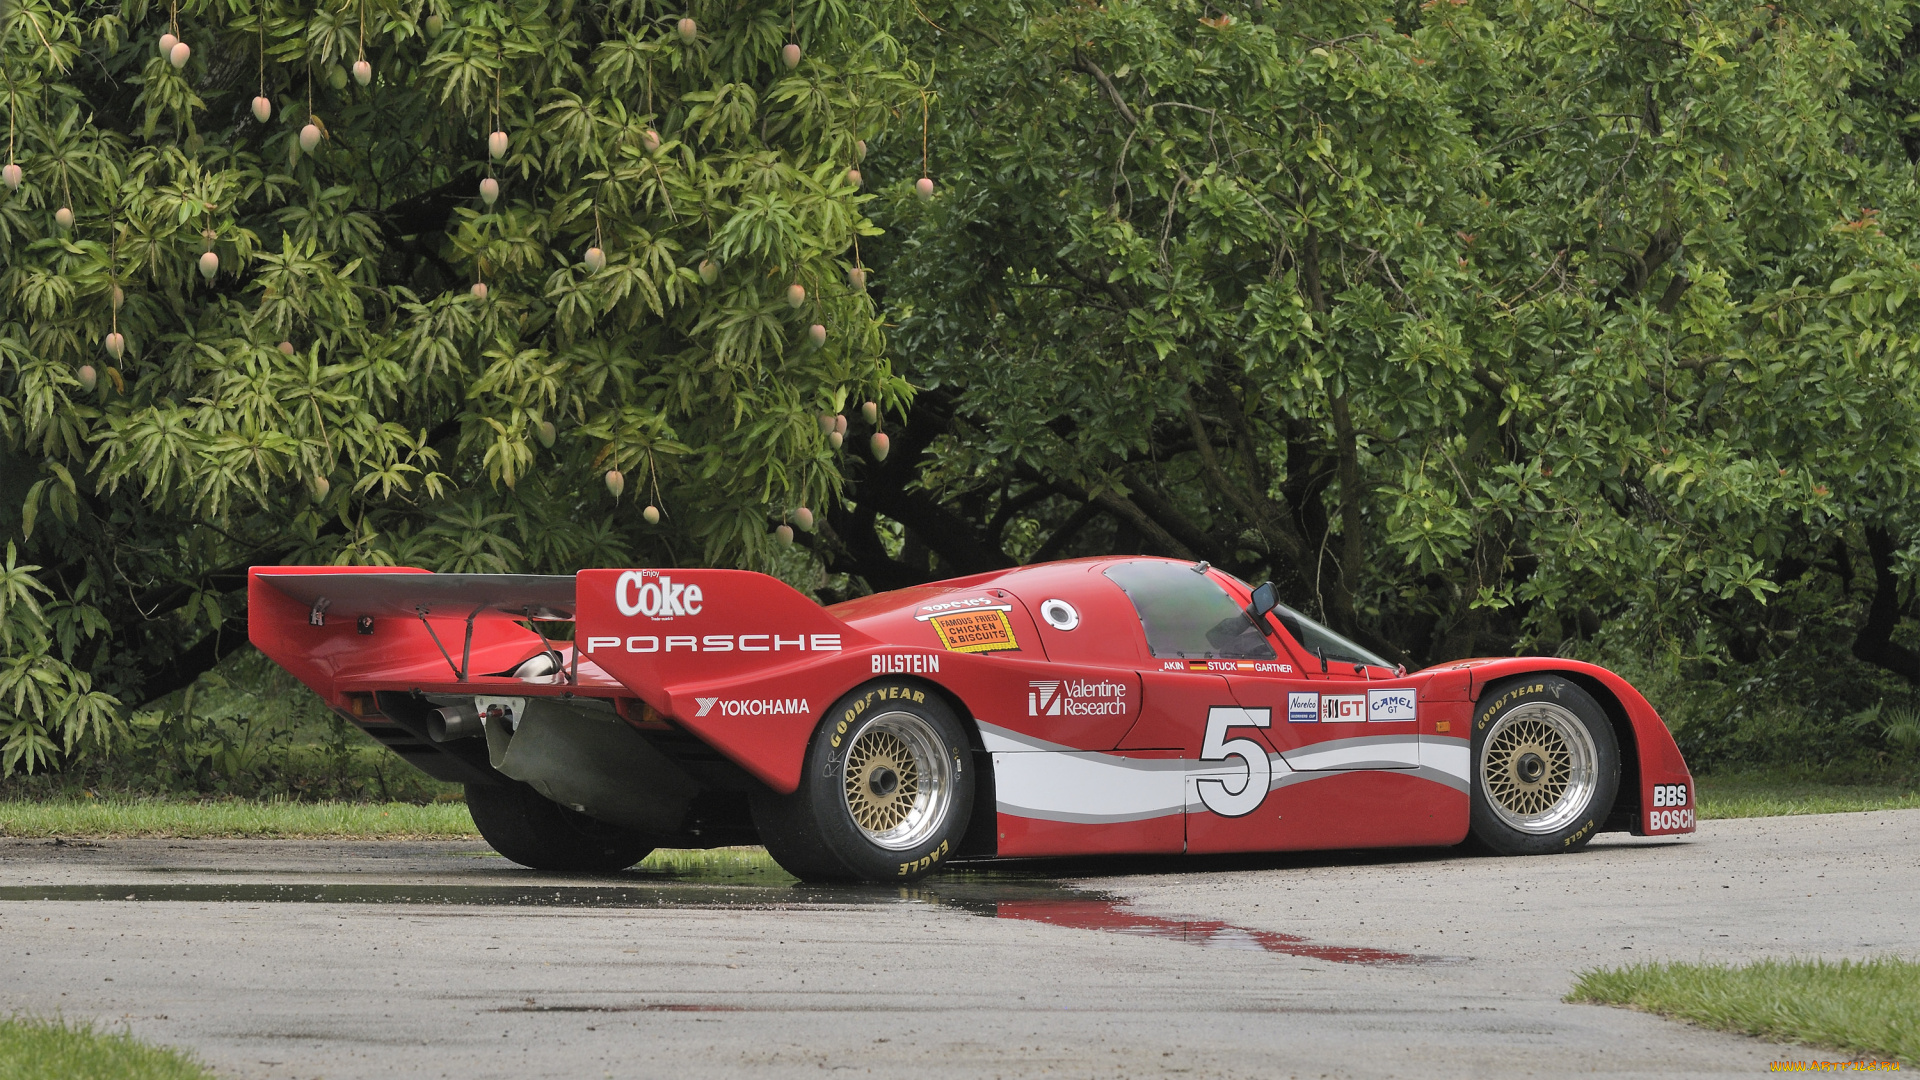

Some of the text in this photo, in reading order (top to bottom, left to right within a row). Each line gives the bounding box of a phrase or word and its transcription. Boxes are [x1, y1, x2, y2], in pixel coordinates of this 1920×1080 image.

[642, 569, 660, 578] Enjoy
[615, 570, 703, 616] Coke
[940, 613, 998, 628] FAMOUS FRIED
[949, 622, 996, 635] CHICKEN
[587, 633, 842, 653] PORSCHE
[949, 630, 1006, 644] & BISCUITS
[871, 654, 940, 673] BILSTEIN
[1164, 661, 1184, 670] AKIN
[1207, 661, 1237, 671] STUCK
[1255, 663, 1293, 673] GARTNER
[1064, 679, 1126, 697] Valentine
[718, 698, 810, 717] YOKOHAMA
[1064, 697, 1126, 716] Research
[1290, 696, 1316, 710] Norelco
[1340, 701, 1364, 716] GT
[1372, 696, 1413, 711] CAMEL
[1387, 705, 1398, 714] GT
[1478, 684, 1544, 731] GOODYEAR
[829, 686, 925, 748] GOODYEAR
[1196, 705, 1273, 818] 5
[1653, 784, 1687, 807] BBS
[1650, 808, 1694, 830] BOSCH
[1564, 819, 1594, 847] EAGLE
[898, 839, 949, 876] EAGLE
